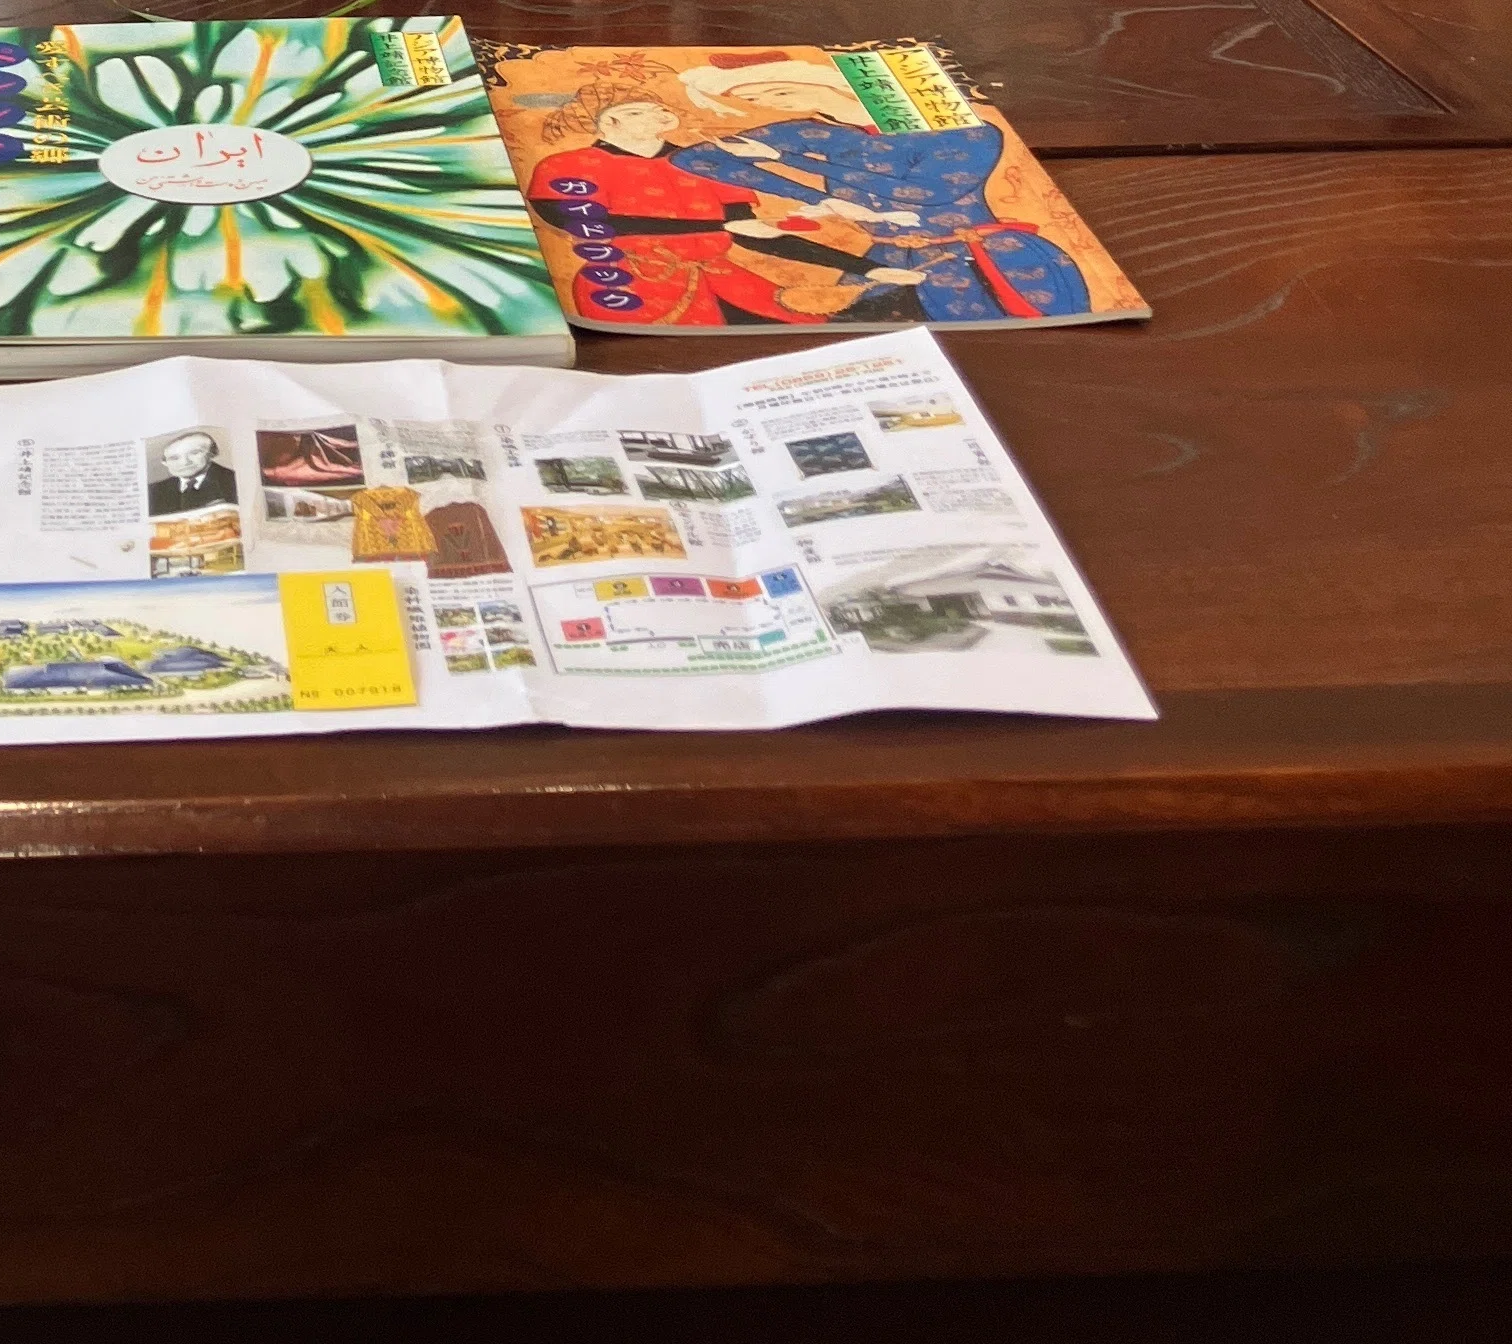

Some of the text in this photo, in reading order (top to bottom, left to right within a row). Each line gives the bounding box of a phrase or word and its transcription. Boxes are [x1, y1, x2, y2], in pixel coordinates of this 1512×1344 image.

[887, 49, 972, 127] アジア博物館
[137, 131, 264, 168] ایران
[559, 180, 632, 308] ガイドブック
